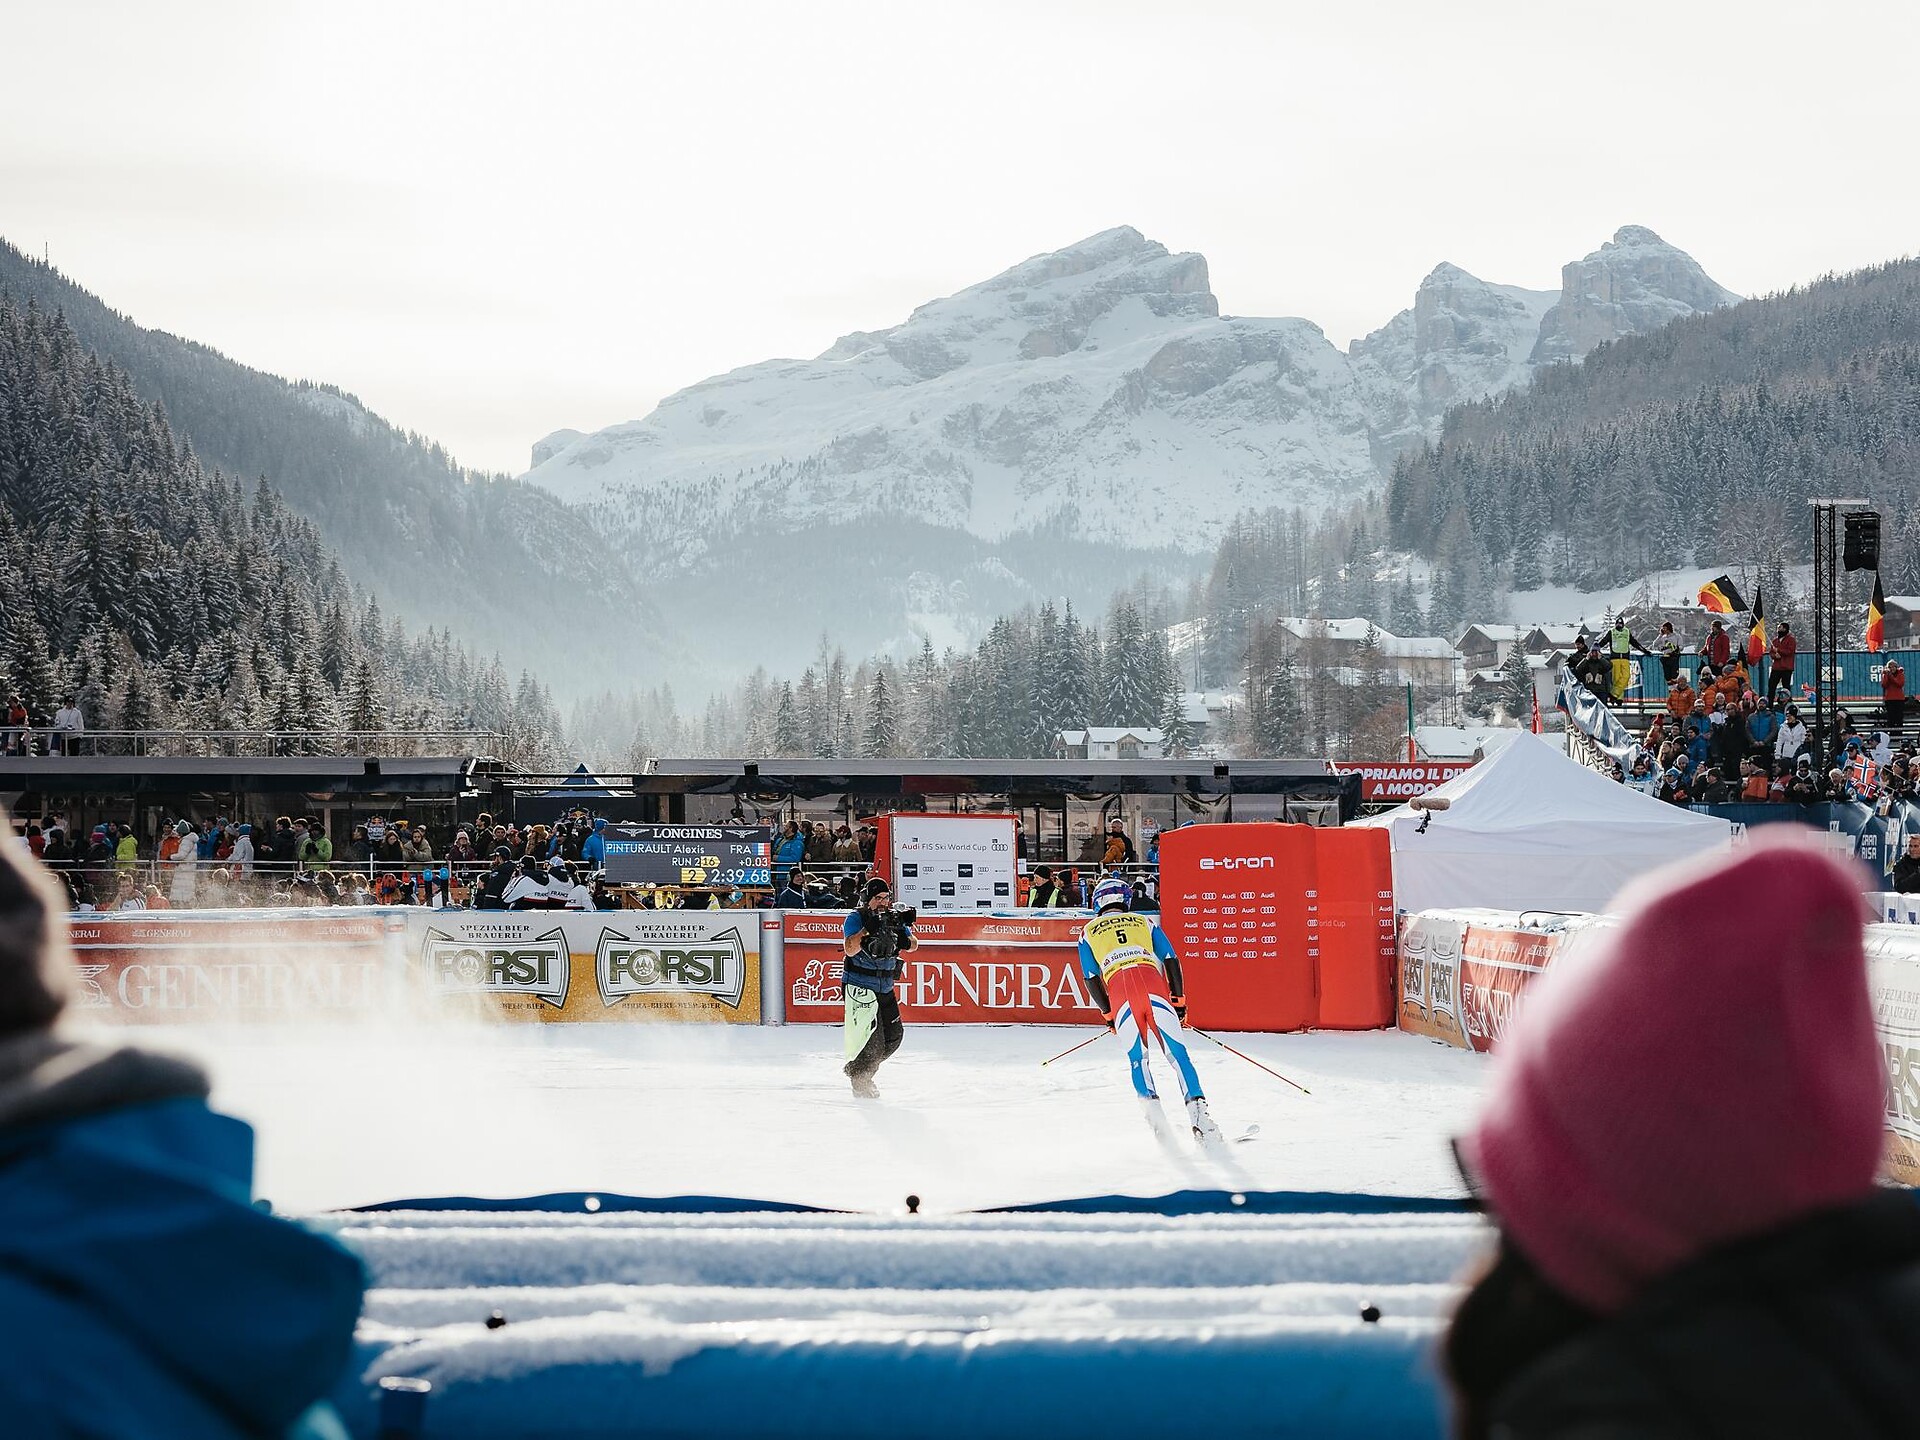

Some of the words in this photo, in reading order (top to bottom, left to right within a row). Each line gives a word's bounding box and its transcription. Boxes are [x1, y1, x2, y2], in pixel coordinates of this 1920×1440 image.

[1427, 768, 1440, 780] IL
[1372, 782, 1385, 795] A
[1387, 782, 1437, 796] MODO
[653, 828, 723, 839] LONGINES
[606, 843, 672, 854] PINTURAULT
[674, 844, 705, 854] Alexis
[730, 844, 752, 854] FRA
[902, 843, 920, 851] Audi
[922, 843, 934, 851] FIS
[935, 843, 947, 851] Ski
[948, 843, 971, 851] World
[972, 843, 987, 852] Cup
[672, 857, 693, 867] RUN
[694, 857, 701, 867] 2
[703, 857, 716, 867] 16
[739, 857, 769, 867] +0.03
[1199, 857, 1275, 870] e-tron
[689, 869, 698, 882] 2
[711, 868, 770, 883] 2:39.68
[1183, 892, 1198, 900] Audi
[1222, 892, 1237, 900] Audi
[1261, 891, 1275, 899] Audi
[1203, 906, 1217, 914] Audi
[1242, 906, 1256, 914] Audi
[1379, 905, 1393, 913] Audi
[635, 924, 709, 932] SPEZIALBIER-
[808, 923, 845, 933] GENERA
[912, 924, 946, 933] NERALI
[1184, 921, 1198, 929] Audi
[1223, 921, 1237, 929] Audi
[1262, 920, 1277, 928] Audi
[146, 928, 192, 938] GENERALI
[996, 925, 1041, 935] GENERALI
[1115, 929, 1128, 944] 5
[1243, 935, 1257, 943] Audi
[1185, 950, 1200, 958] Audi
[1263, 950, 1278, 958] Audi
[434, 948, 559, 985] FORST
[609, 948, 733, 985] FORST
[118, 964, 377, 1009] GENERALI
[892, 961, 1101, 1009] ENERA
